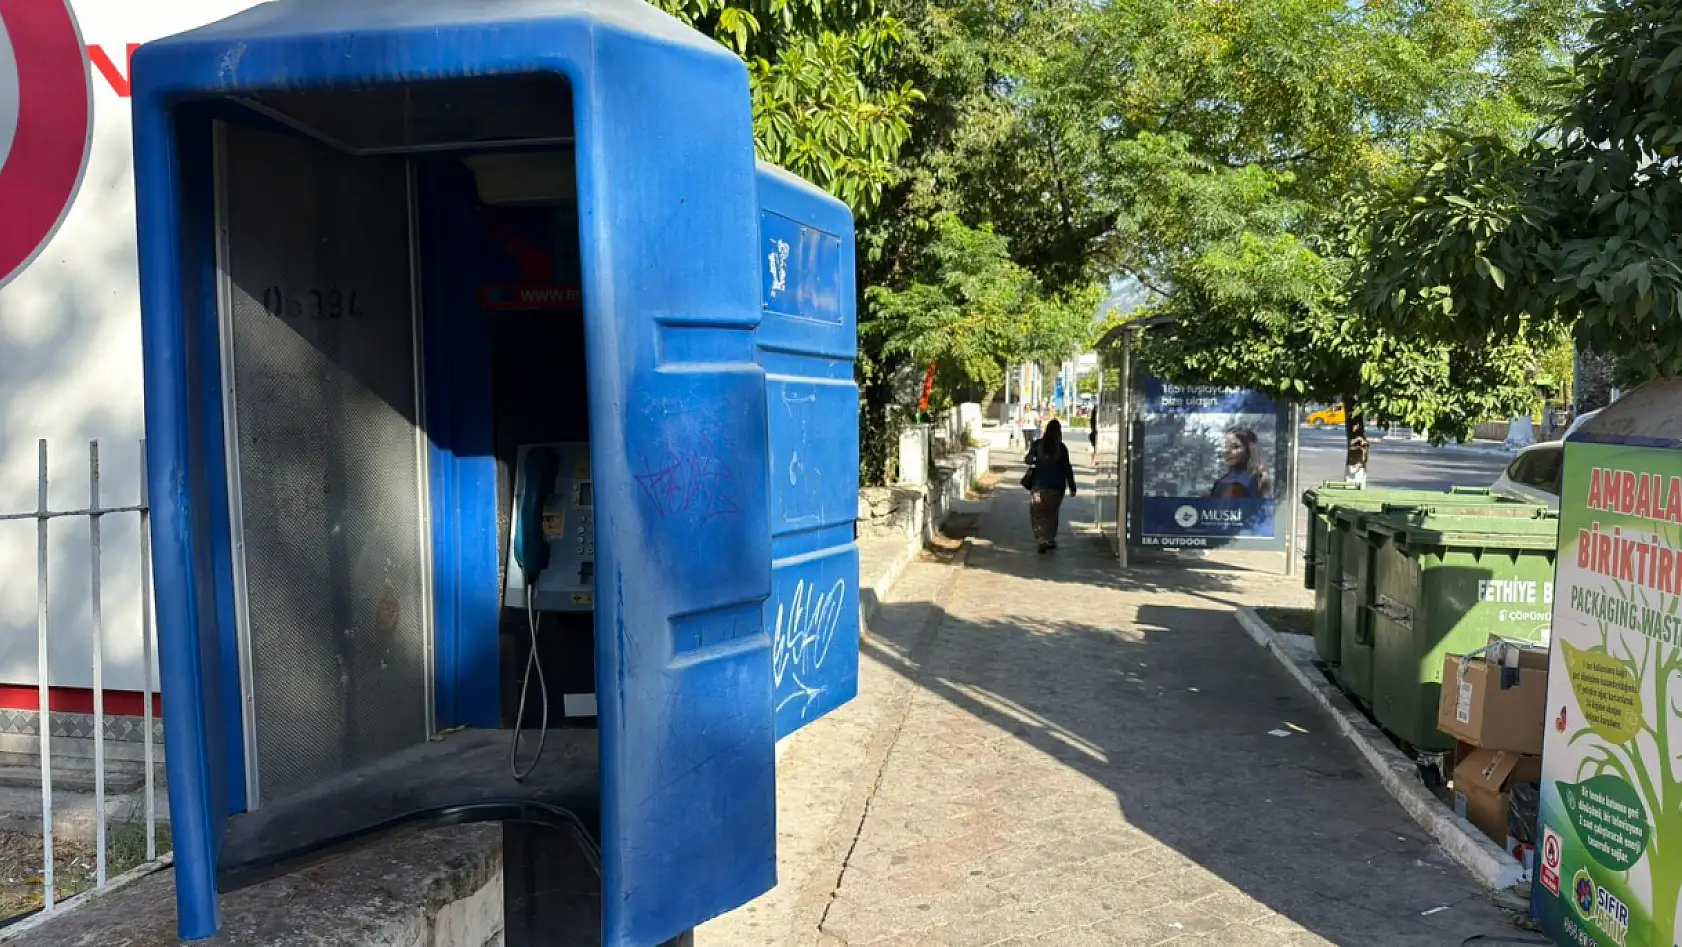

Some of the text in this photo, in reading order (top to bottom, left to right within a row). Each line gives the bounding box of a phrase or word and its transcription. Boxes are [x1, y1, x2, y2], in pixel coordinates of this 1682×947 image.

[1161, 536, 1208, 546] OUTDOOR
[1479, 575, 1536, 602] FETHİYE
[1571, 584, 1637, 631] PACKAGING
[1598, 886, 1628, 926] SIFIR
